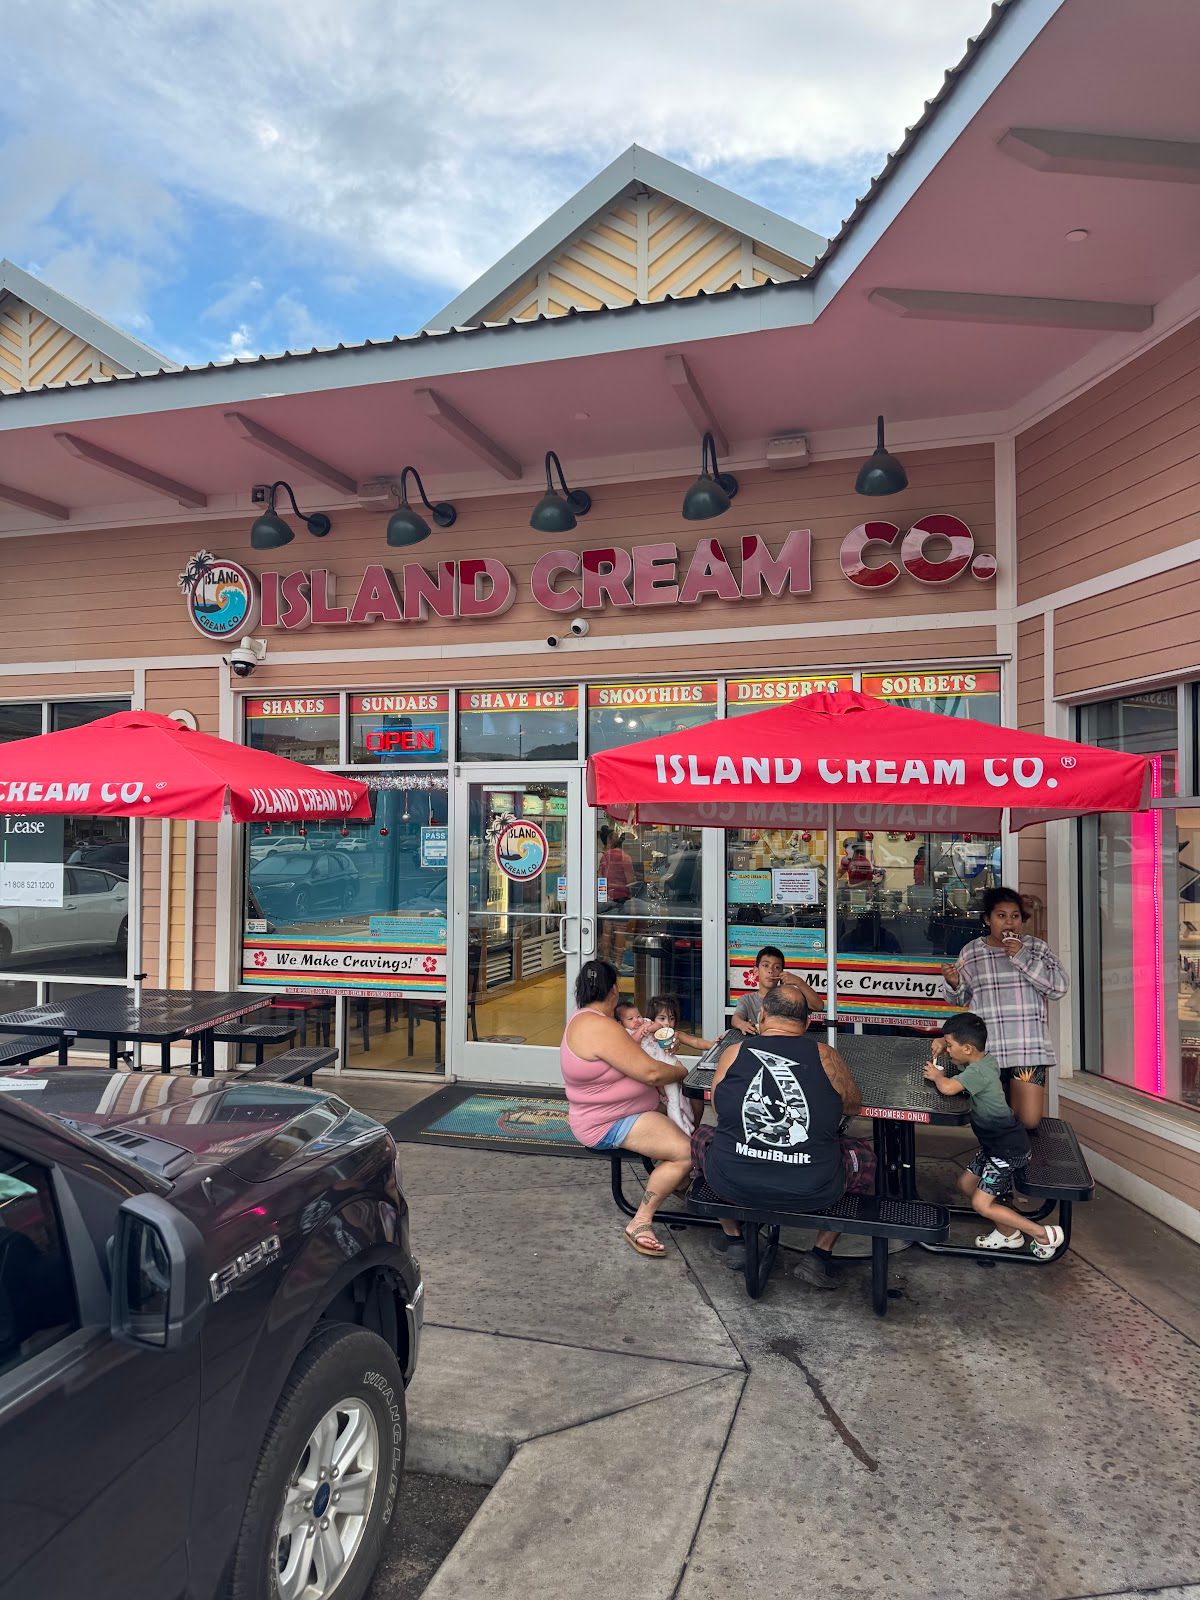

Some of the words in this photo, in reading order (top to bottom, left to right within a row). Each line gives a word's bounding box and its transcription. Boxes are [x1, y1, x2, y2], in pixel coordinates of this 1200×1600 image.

[205, 569, 239, 585] ISLAND
[260, 557, 513, 629] ISLAND
[530, 529, 812, 612] CREAM
[839, 513, 998, 589] CO.
[200, 615, 226, 630] CREAM
[881, 674, 977, 694] SORBETS
[361, 695, 438, 711] SUNDAES
[470, 692, 529, 708] SHAVE
[535, 691, 565, 706] ICE
[599, 686, 703, 704] SMOOTHIES
[262, 700, 325, 714] SHAKES
[365, 730, 435, 751] OPEN
[655, 754, 802, 785] ISLAND
[817, 758, 965, 784] CREAM
[248, 788, 299, 814] ISLAND
[297, 788, 337, 811] CREAM
[4, 817, 45, 834] Lease
[508, 827, 536, 838] ISLAND
[425, 832, 446, 840] PASS
[504, 862, 527, 875] CREAM
[39, 881, 55, 889] 1200
[277, 953, 297, 965] We
[301, 954, 339, 967] Make
[343, 955, 413, 973] Cravings!
[865, 1108, 905, 1120] CUSTOMERS
[907, 1112, 927, 1122] ONLY!
[735, 1142, 812, 1164] MauiBuilt
[265, 1250, 280, 1266] XLT
[363, 1371, 402, 1525] WRANGLER
